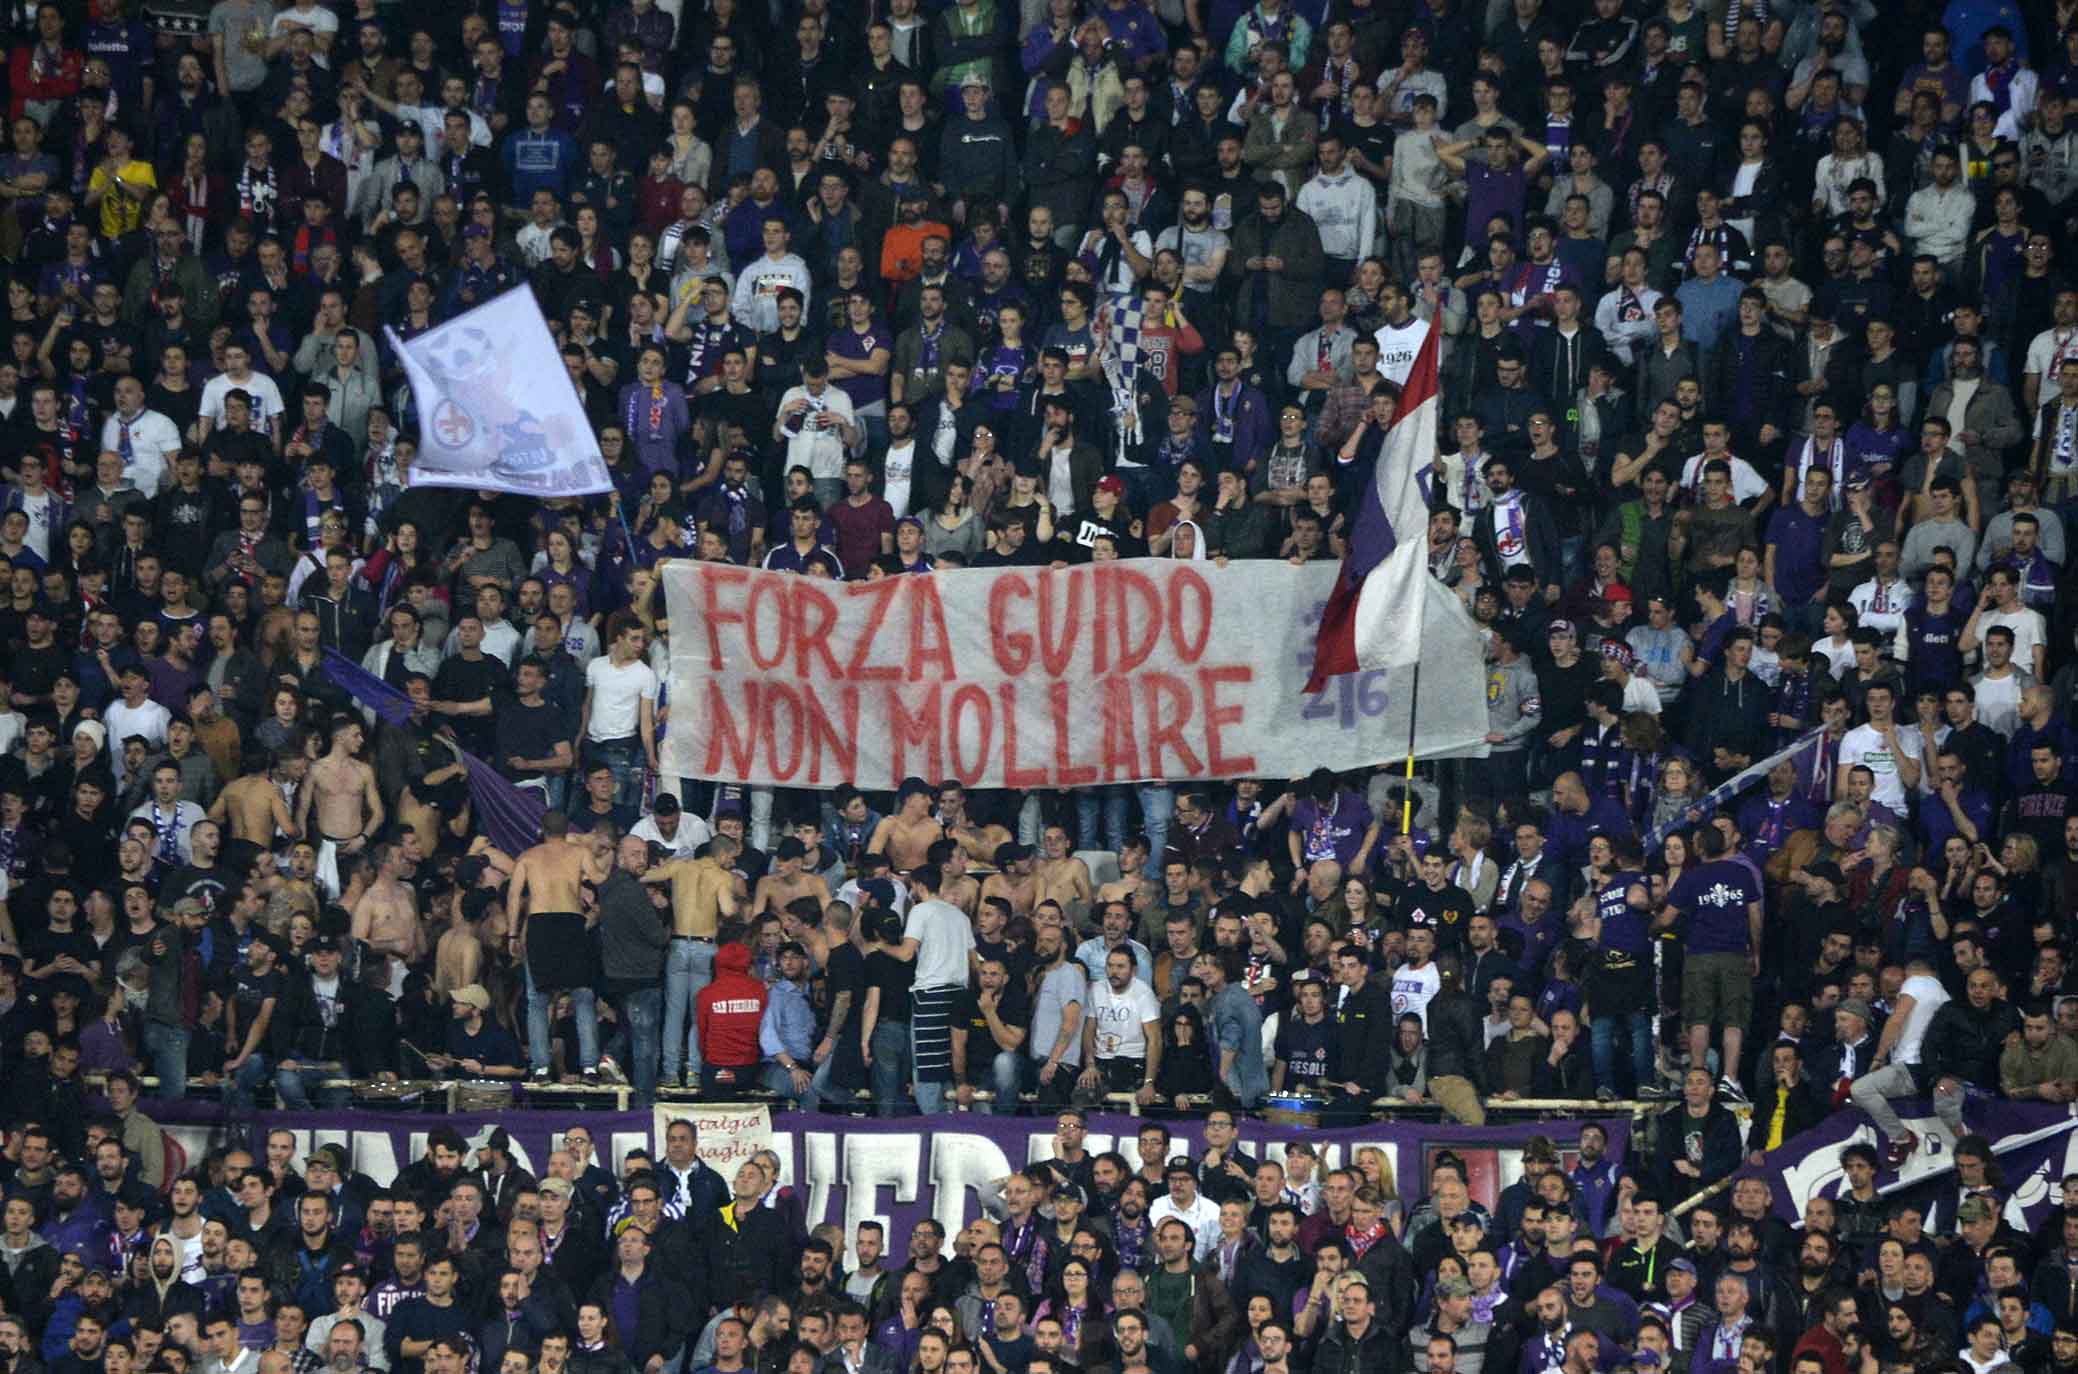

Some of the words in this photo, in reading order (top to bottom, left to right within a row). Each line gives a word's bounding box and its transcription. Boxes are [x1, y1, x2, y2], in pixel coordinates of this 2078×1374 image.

[701, 565, 957, 682] FORZA
[987, 564, 1214, 678] GUIDO
[704, 679, 859, 785] NON
[888, 665, 1256, 789] MOLLARE
